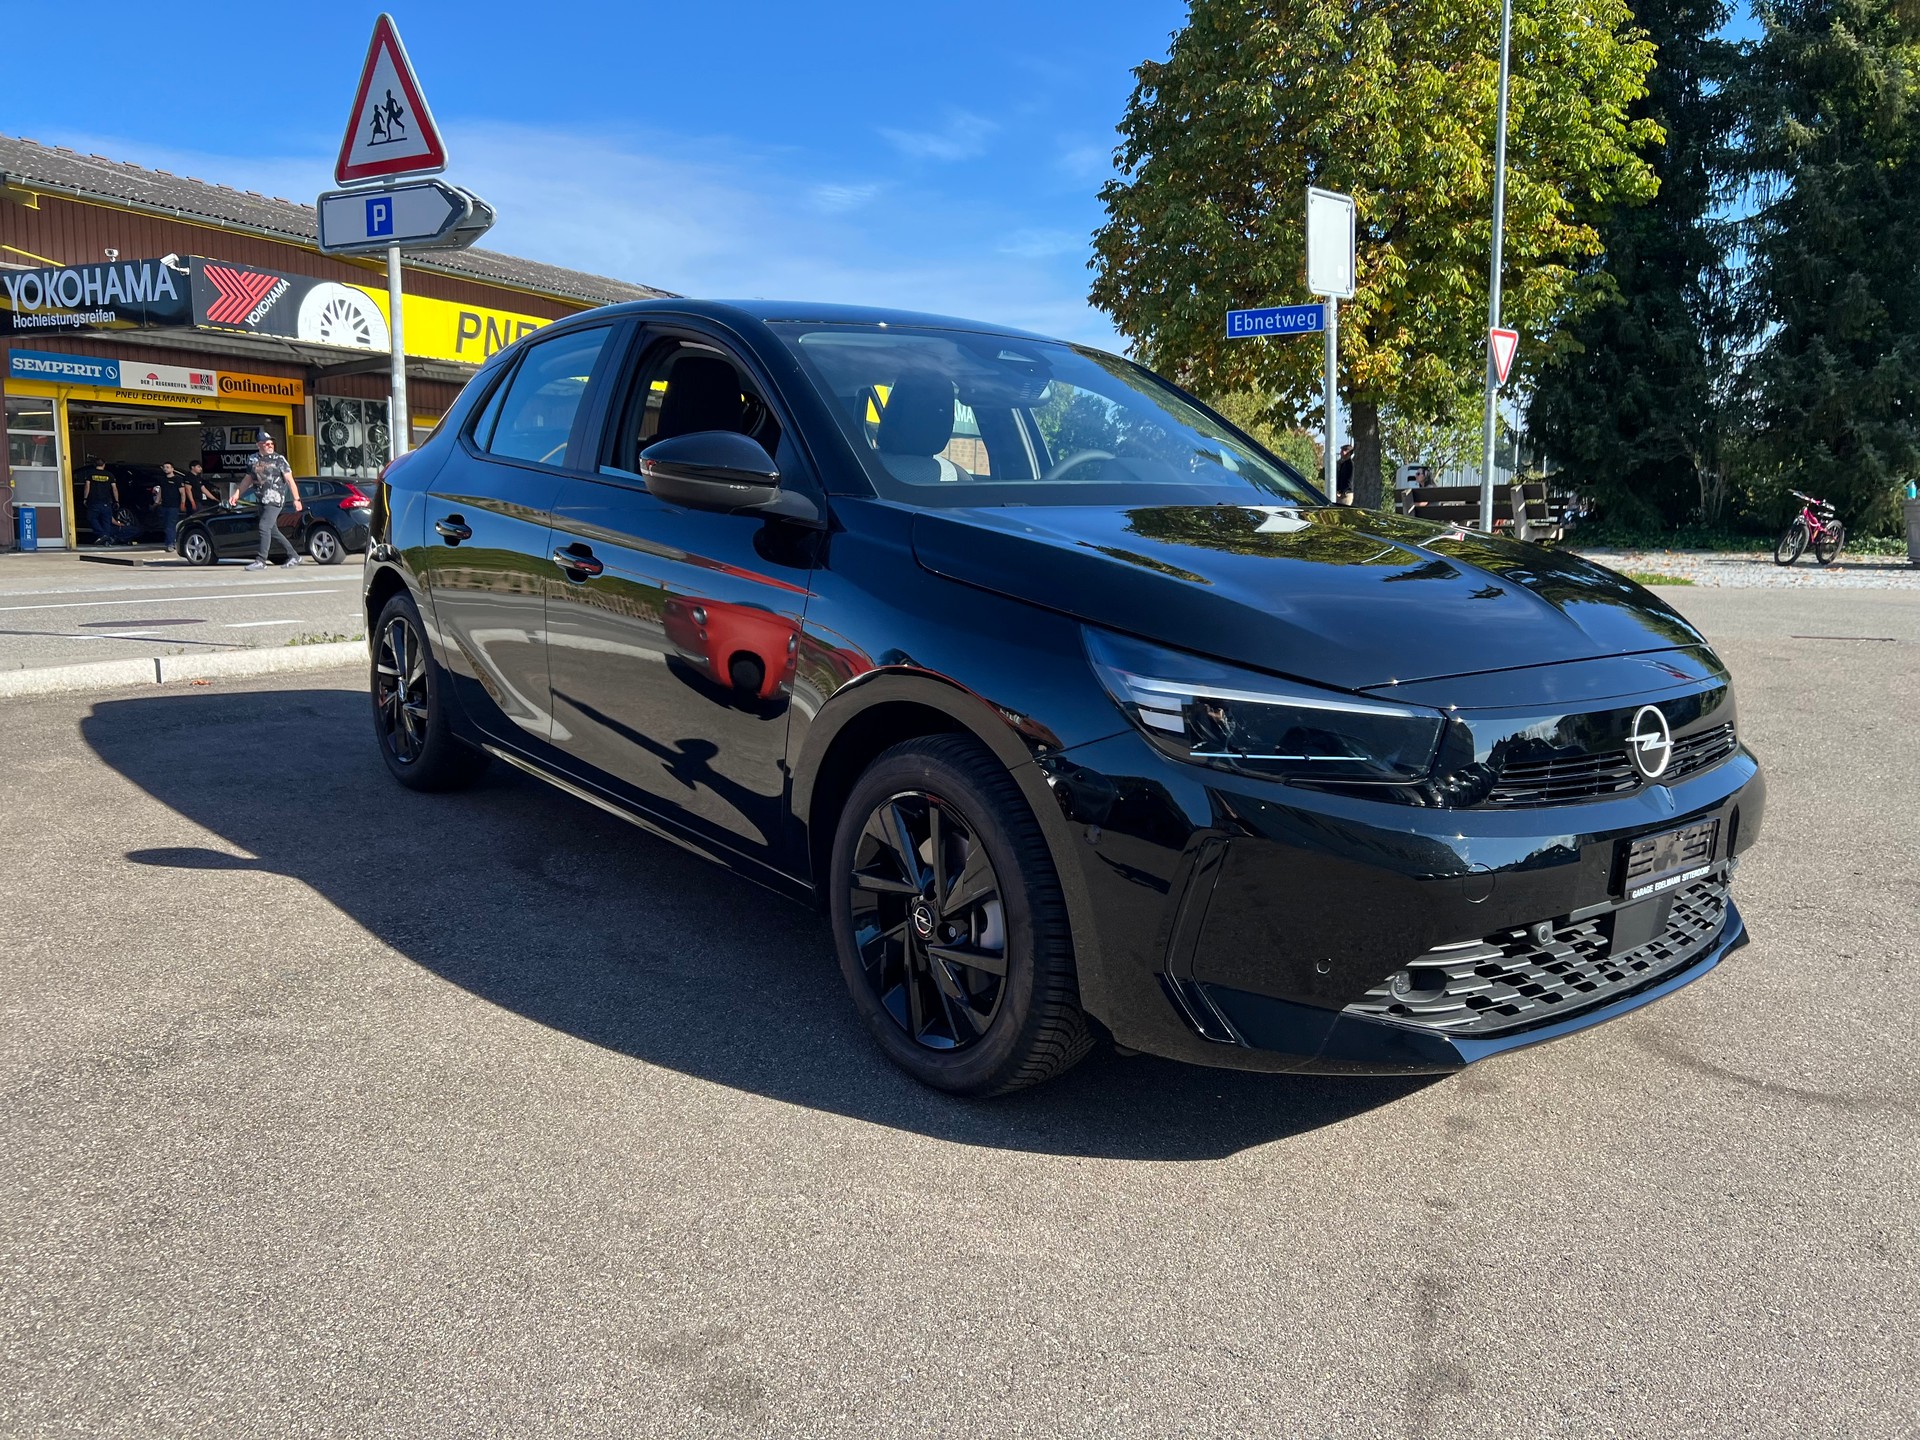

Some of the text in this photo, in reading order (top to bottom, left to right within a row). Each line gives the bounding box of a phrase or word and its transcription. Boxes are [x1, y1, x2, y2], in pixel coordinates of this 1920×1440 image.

[373, 203, 386, 231] P
[3, 262, 178, 311] YOKOHAMA
[244, 278, 291, 327] YOKOHAMA
[13, 309, 116, 328] Hochleistungsreifen
[1234, 312, 1317, 332] Ebnetweg
[12, 357, 102, 377] SEMPERIT
[218, 375, 294, 397] Continental
[115, 390, 202, 405] PNEU EDELMANN AG
[111, 421, 156, 430] Sava Tires
[1632, 884, 1654, 899] GARAGE
[1655, 875, 1681, 891] EDELMANN
